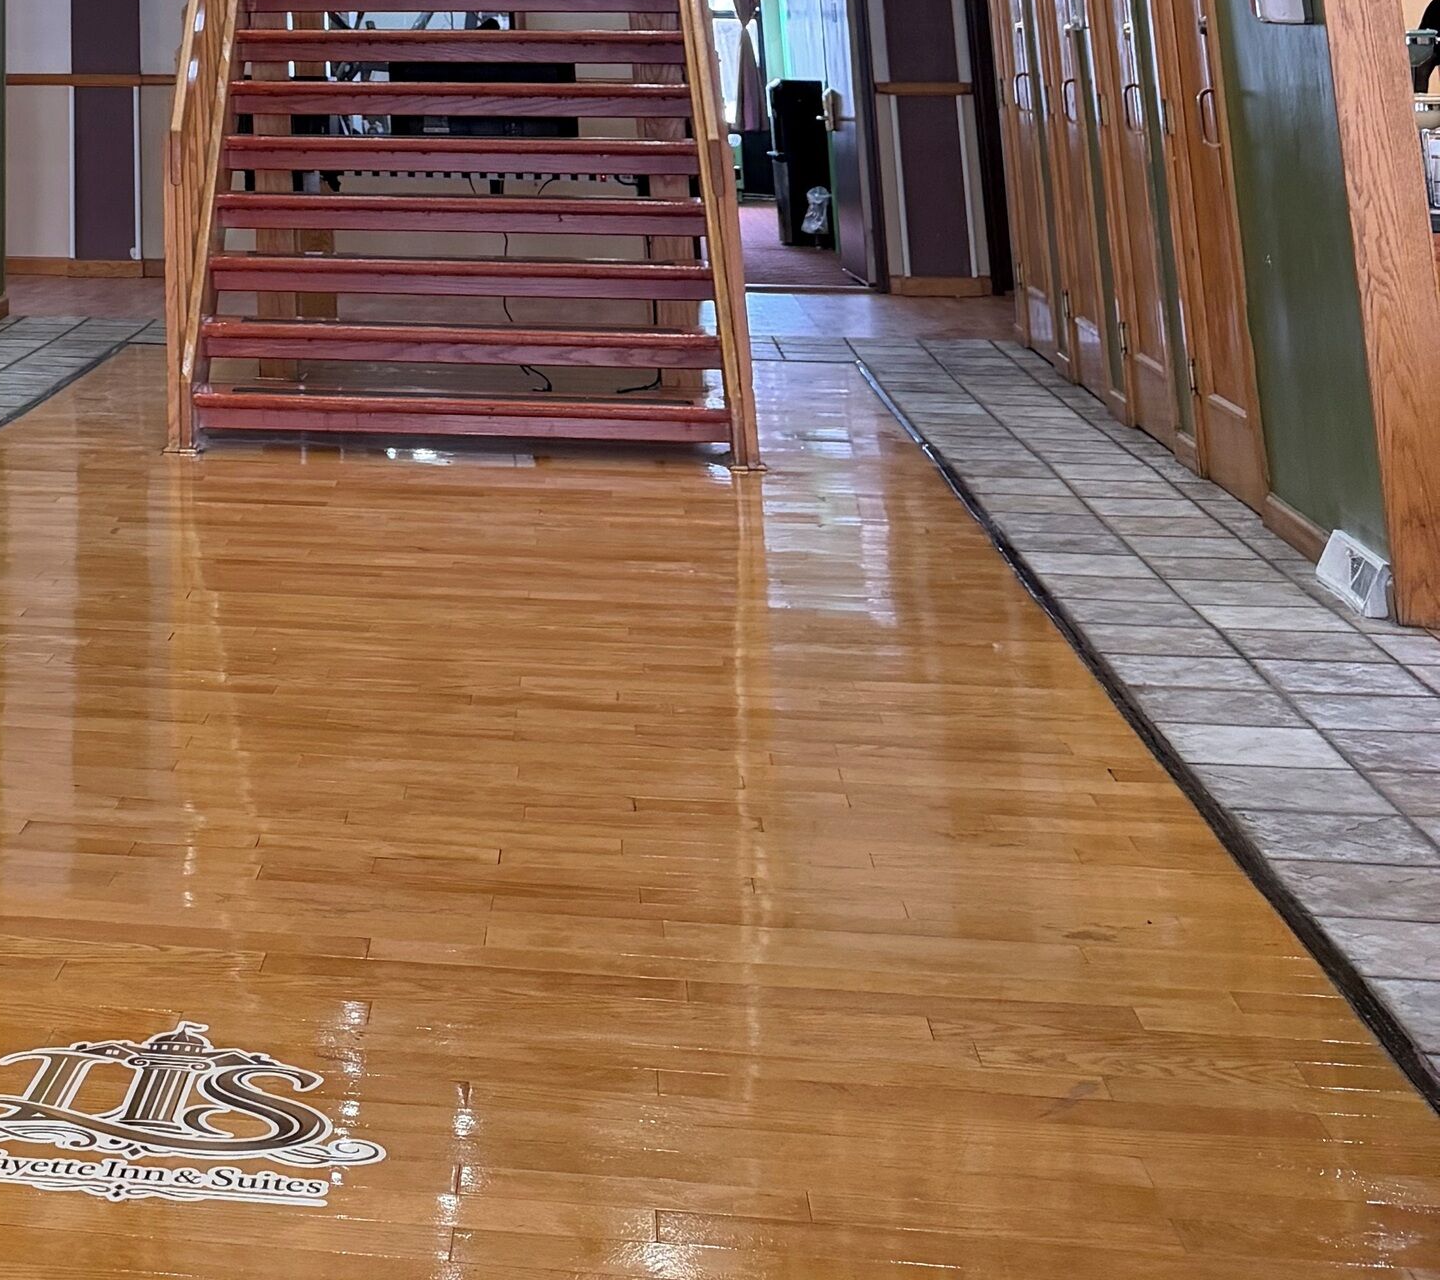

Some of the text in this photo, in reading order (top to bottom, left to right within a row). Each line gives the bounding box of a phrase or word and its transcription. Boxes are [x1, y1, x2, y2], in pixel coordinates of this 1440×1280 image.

[104, 1161, 165, 1182] Inn
[173, 1169, 202, 1185] &
[211, 1168, 323, 1195] Suites
